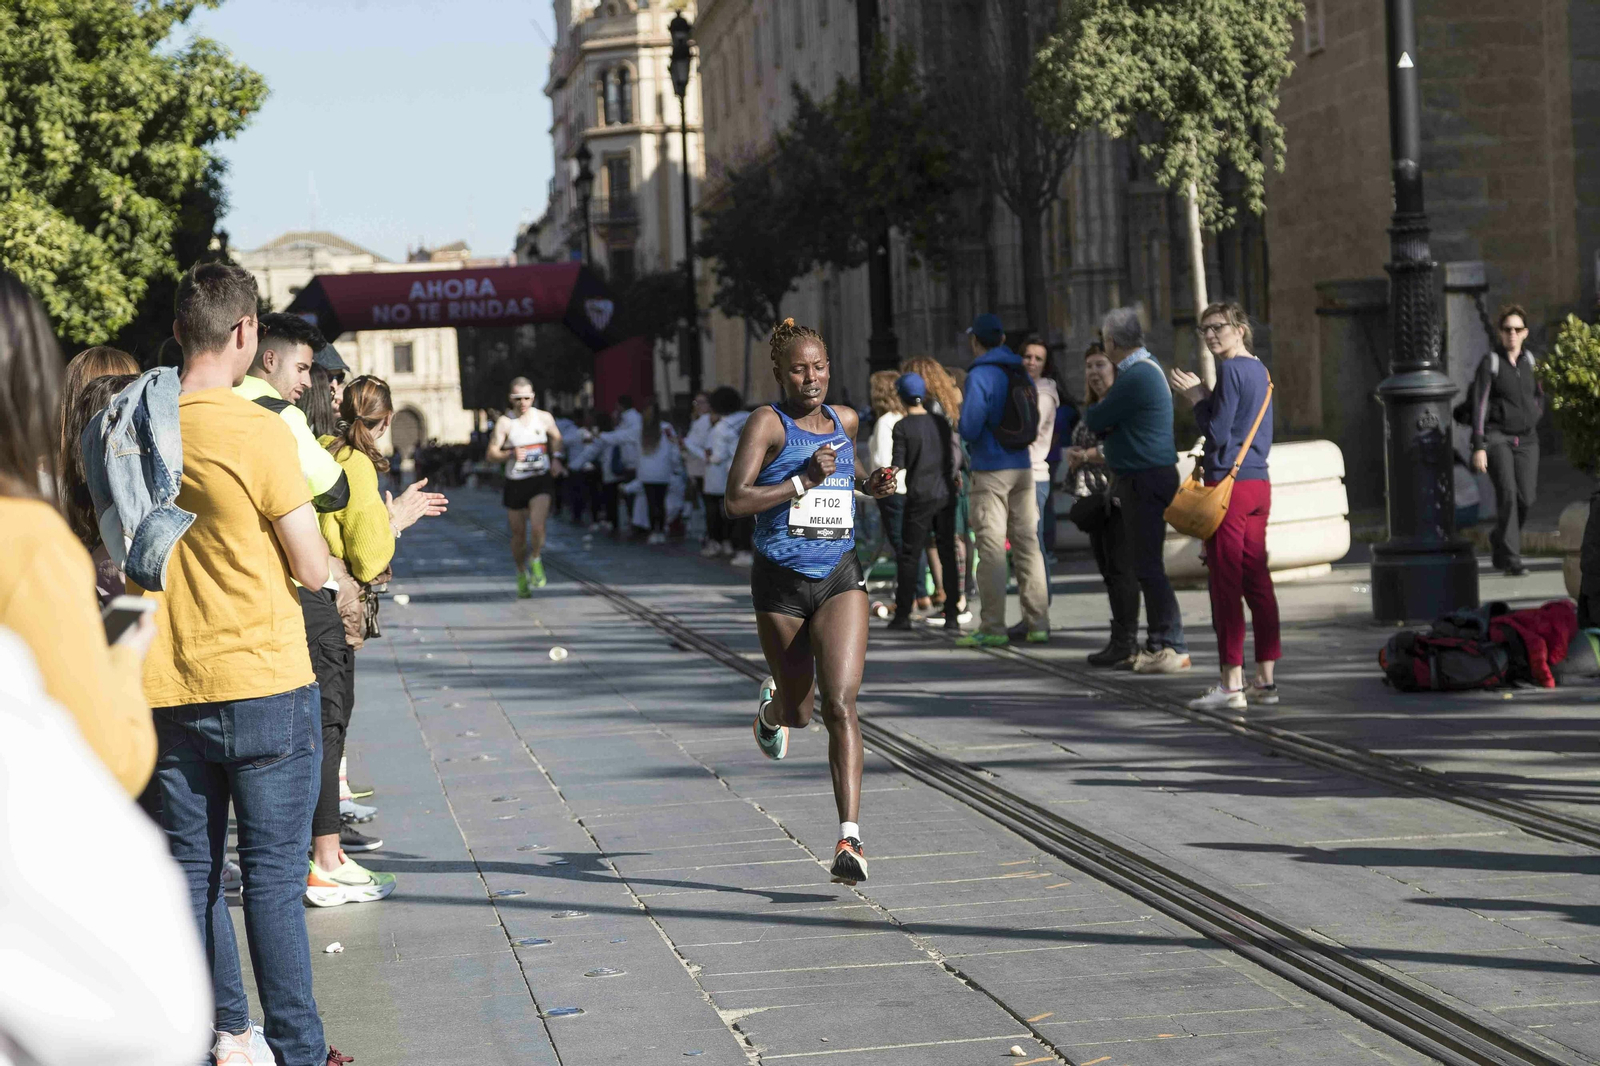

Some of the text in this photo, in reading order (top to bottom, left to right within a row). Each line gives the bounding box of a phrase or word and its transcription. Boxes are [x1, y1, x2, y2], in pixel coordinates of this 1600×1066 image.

[408, 277, 497, 300] AHORA
[372, 297, 534, 324] NO TE RINDAS
[819, 478, 850, 487] URICH
[814, 498, 841, 508] F102
[809, 516, 843, 525] MELKAM
